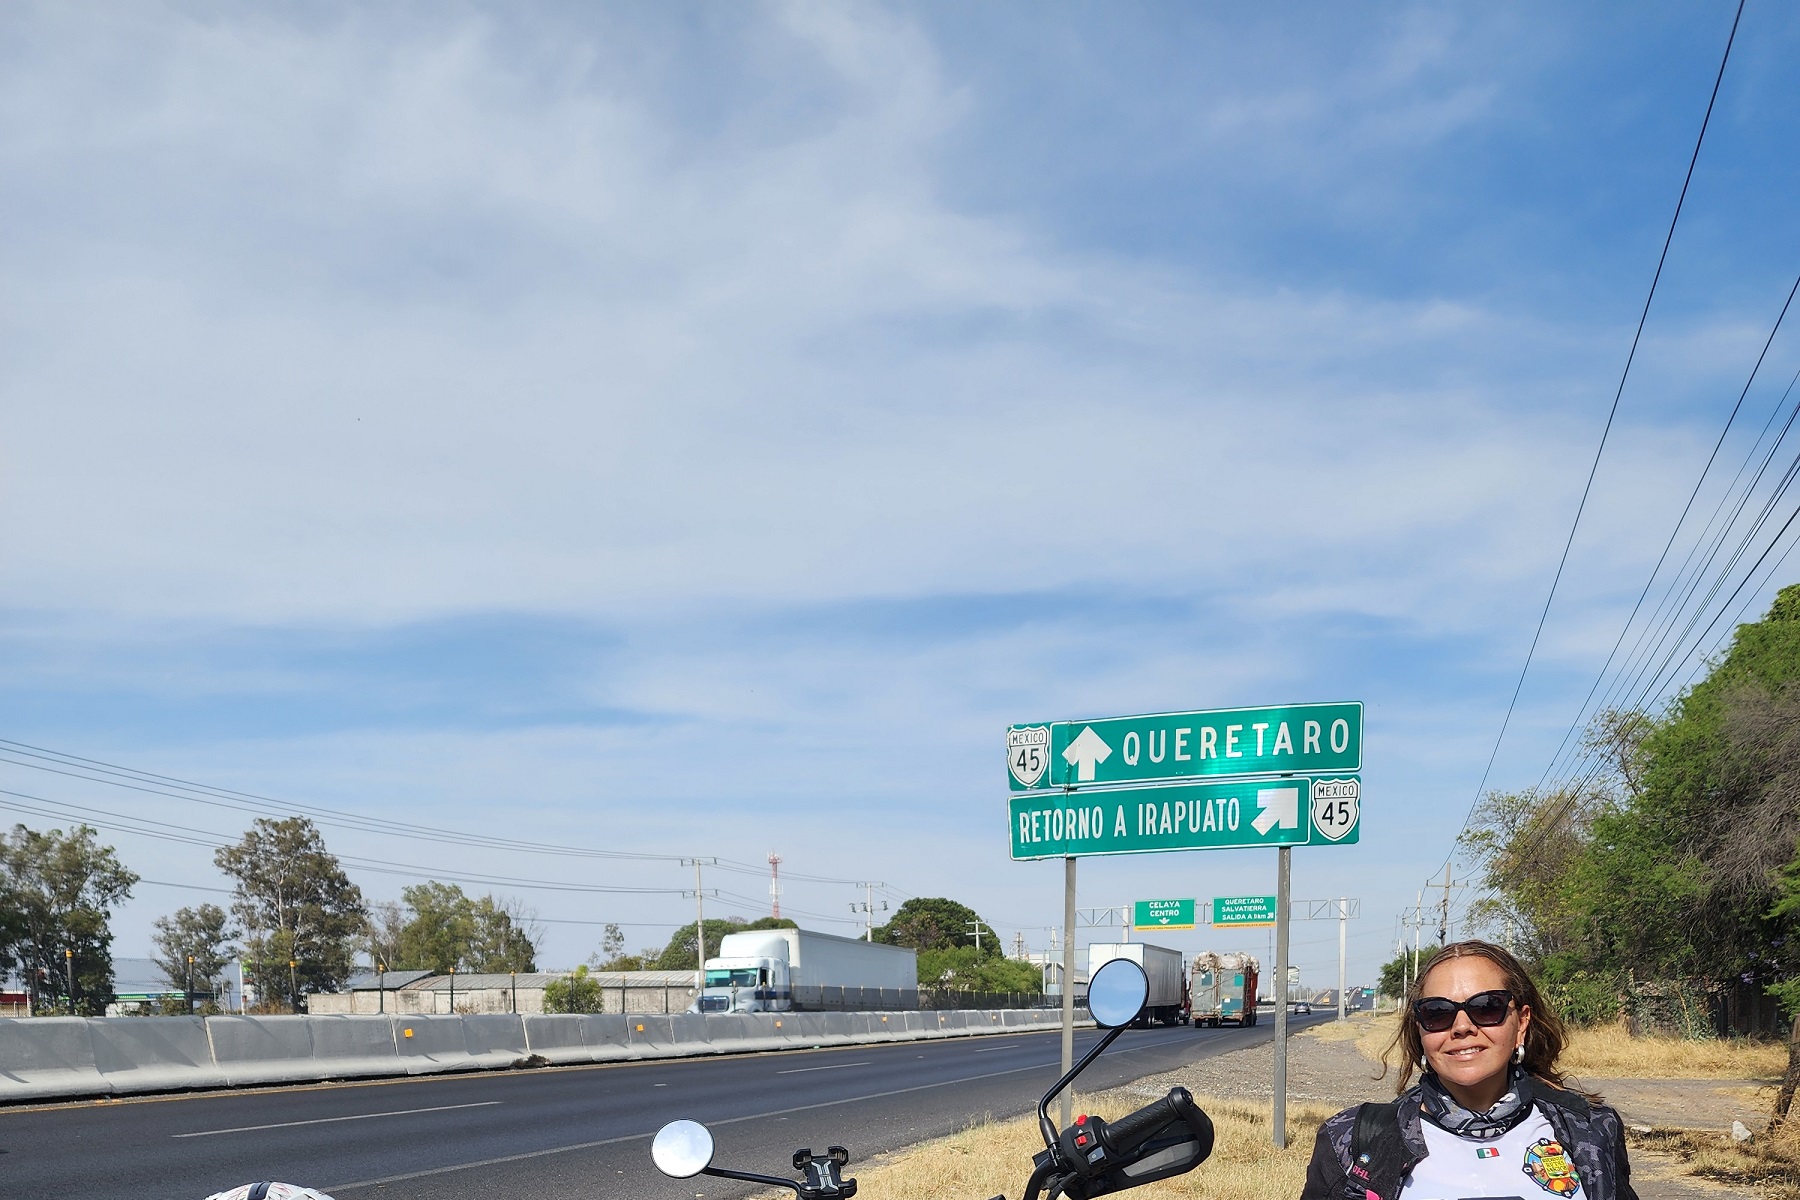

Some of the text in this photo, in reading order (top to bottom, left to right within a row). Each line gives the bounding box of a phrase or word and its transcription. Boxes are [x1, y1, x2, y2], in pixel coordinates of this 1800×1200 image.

[1012, 731, 1045, 746] MEXICO
[1122, 717, 1350, 767] QUERETARO
[1016, 749, 1040, 773] 45
[1317, 785, 1355, 798] MEXICO
[1019, 797, 1241, 844] RETORNO A IRAPUATO
[1321, 801, 1350, 827] 45
[1149, 900, 1180, 909] CELAYA
[1150, 909, 1179, 917] CENTRO
[1222, 913, 1246, 921] SALIDA
